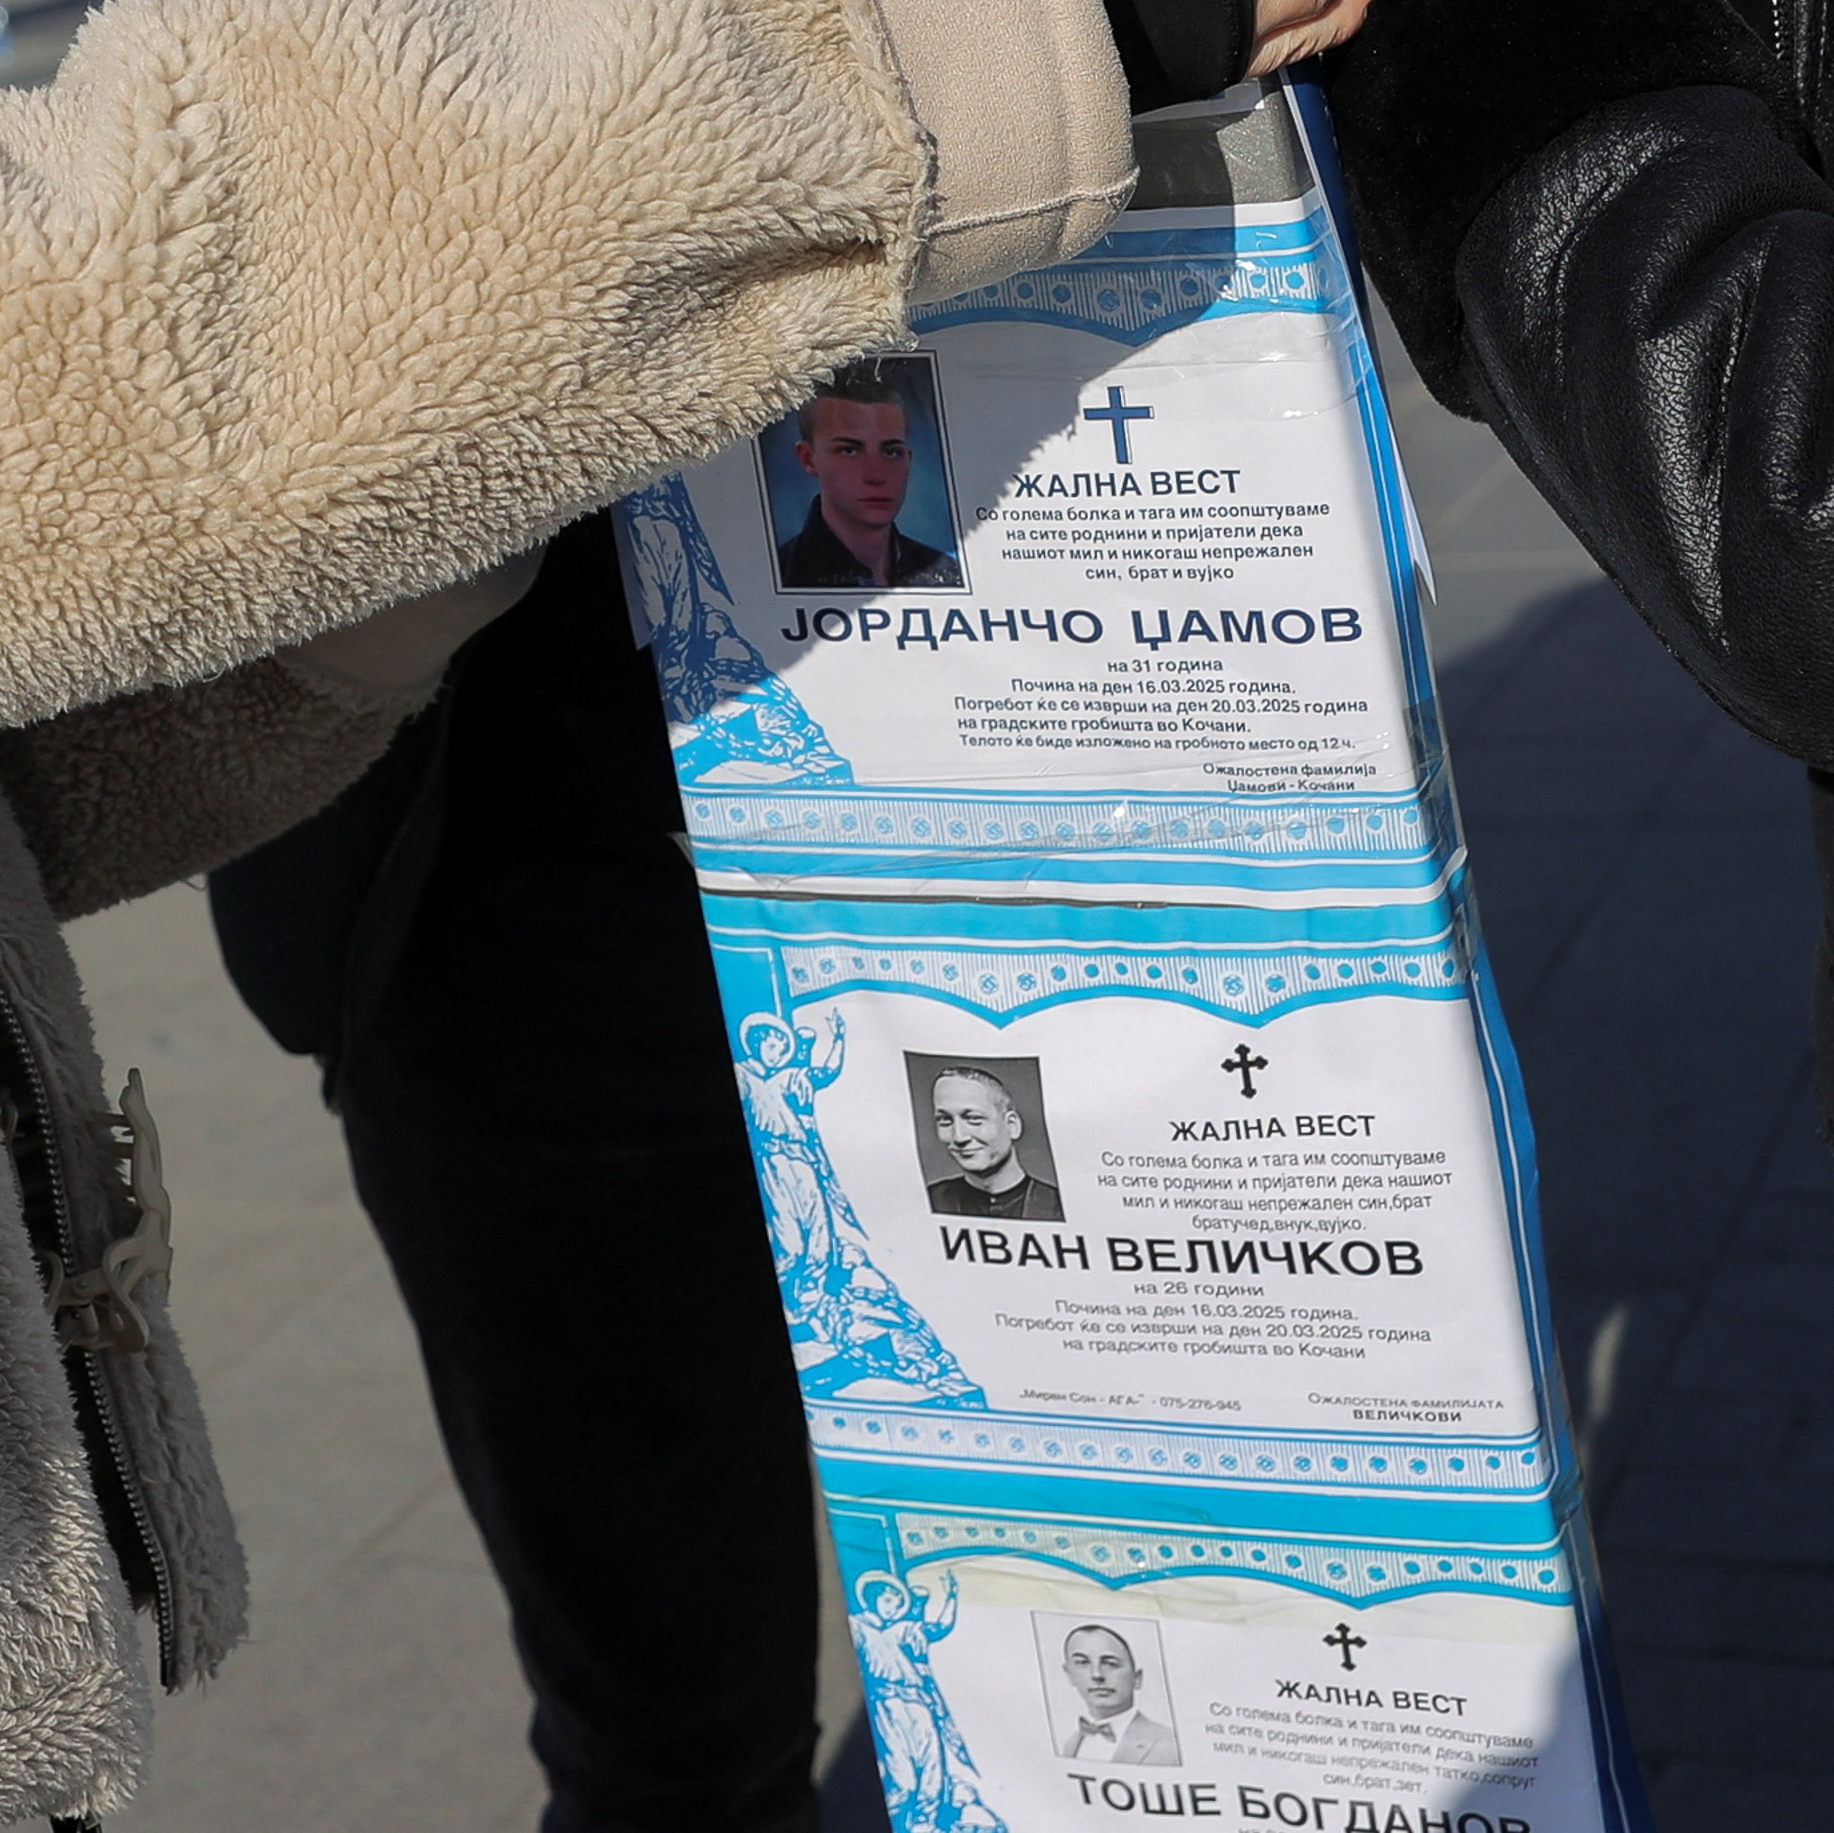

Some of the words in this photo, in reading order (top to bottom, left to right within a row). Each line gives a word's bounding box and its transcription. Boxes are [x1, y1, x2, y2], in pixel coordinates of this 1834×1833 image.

[1014, 472, 1143, 498] ЖАЛНА
[1150, 469, 1241, 496] ВЕСТ
[976, 506, 999, 522] Со
[1002, 508, 1064, 523] голема
[1066, 506, 1122, 522] болка
[1124, 509, 1135, 520] и
[1138, 507, 1176, 520] тага
[1179, 507, 1204, 519] им
[1207, 503, 1330, 521] соопштуваме
[1006, 529, 1027, 541] на
[1029, 529, 1068, 541] сите
[1071, 529, 1148, 544] роднини
[1151, 529, 1162, 540] и
[1165, 524, 1256, 543] пријатели
[1260, 525, 1303, 541] дека
[1001, 548, 1066, 560] нашиот
[1069, 549, 1104, 561] мил
[1107, 549, 1119, 560] и
[1121, 548, 1198, 560] никогаш
[1201, 545, 1314, 562] непрежален
[1085, 568, 1122, 581] син,
[1128, 565, 1169, 583] брат
[1172, 568, 1183, 579] и
[1186, 564, 1234, 583] вујко
[780, 607, 1104, 652] ЈОРДАНЧО
[1130, 607, 1363, 652] ЏАМОВ
[1107, 661, 1129, 673] на
[1132, 659, 1151, 673] 31
[1156, 660, 1224, 674] година
[1011, 678, 1075, 692] Почина
[1078, 681, 1099, 693] на
[1102, 682, 1133, 696] ден
[1136, 678, 1226, 694] 16.03.2025
[1229, 681, 1296, 697] година.
[954, 696, 1034, 714] Погребот
[1037, 696, 1058, 711] ќе
[1060, 700, 1080, 711] се
[1083, 700, 1148, 715] изврши
[1151, 701, 1173, 713] на
[1176, 701, 1209, 716] ден
[1211, 698, 1301, 714] 20.03.2025
[1304, 701, 1368, 716] година
[1202, 762, 1299, 778] Ожалостена
[1300, 763, 1377, 778] фамилија
[1168, 1117, 1287, 1142] ЖАЛНА
[1295, 1114, 1376, 1137] ВЕСТ
[1101, 1151, 1125, 1167] Со
[1128, 1156, 1188, 1169] голема
[1191, 1153, 1243, 1169] болка
[1247, 1156, 1258, 1168] и
[1261, 1153, 1299, 1167] тага
[1303, 1153, 1326, 1166] им
[1330, 1151, 1446, 1168] соопштуваме
[939, 1225, 1091, 1271] ИВАН
[1105, 1236, 1424, 1276] ВЕЛИЧКОВ
[1134, 1283, 1158, 1294] на
[1163, 1281, 1188, 1295] 26
[1194, 1284, 1265, 1299] години
[1352, 1409, 1462, 1422] ВЕЛИЧКОВИ
[1275, 1679, 1384, 1709] ЖАЛНА
[1392, 1690, 1468, 1717] ВЕСТ
[1066, 1773, 1223, 1817] ТОШЕ
